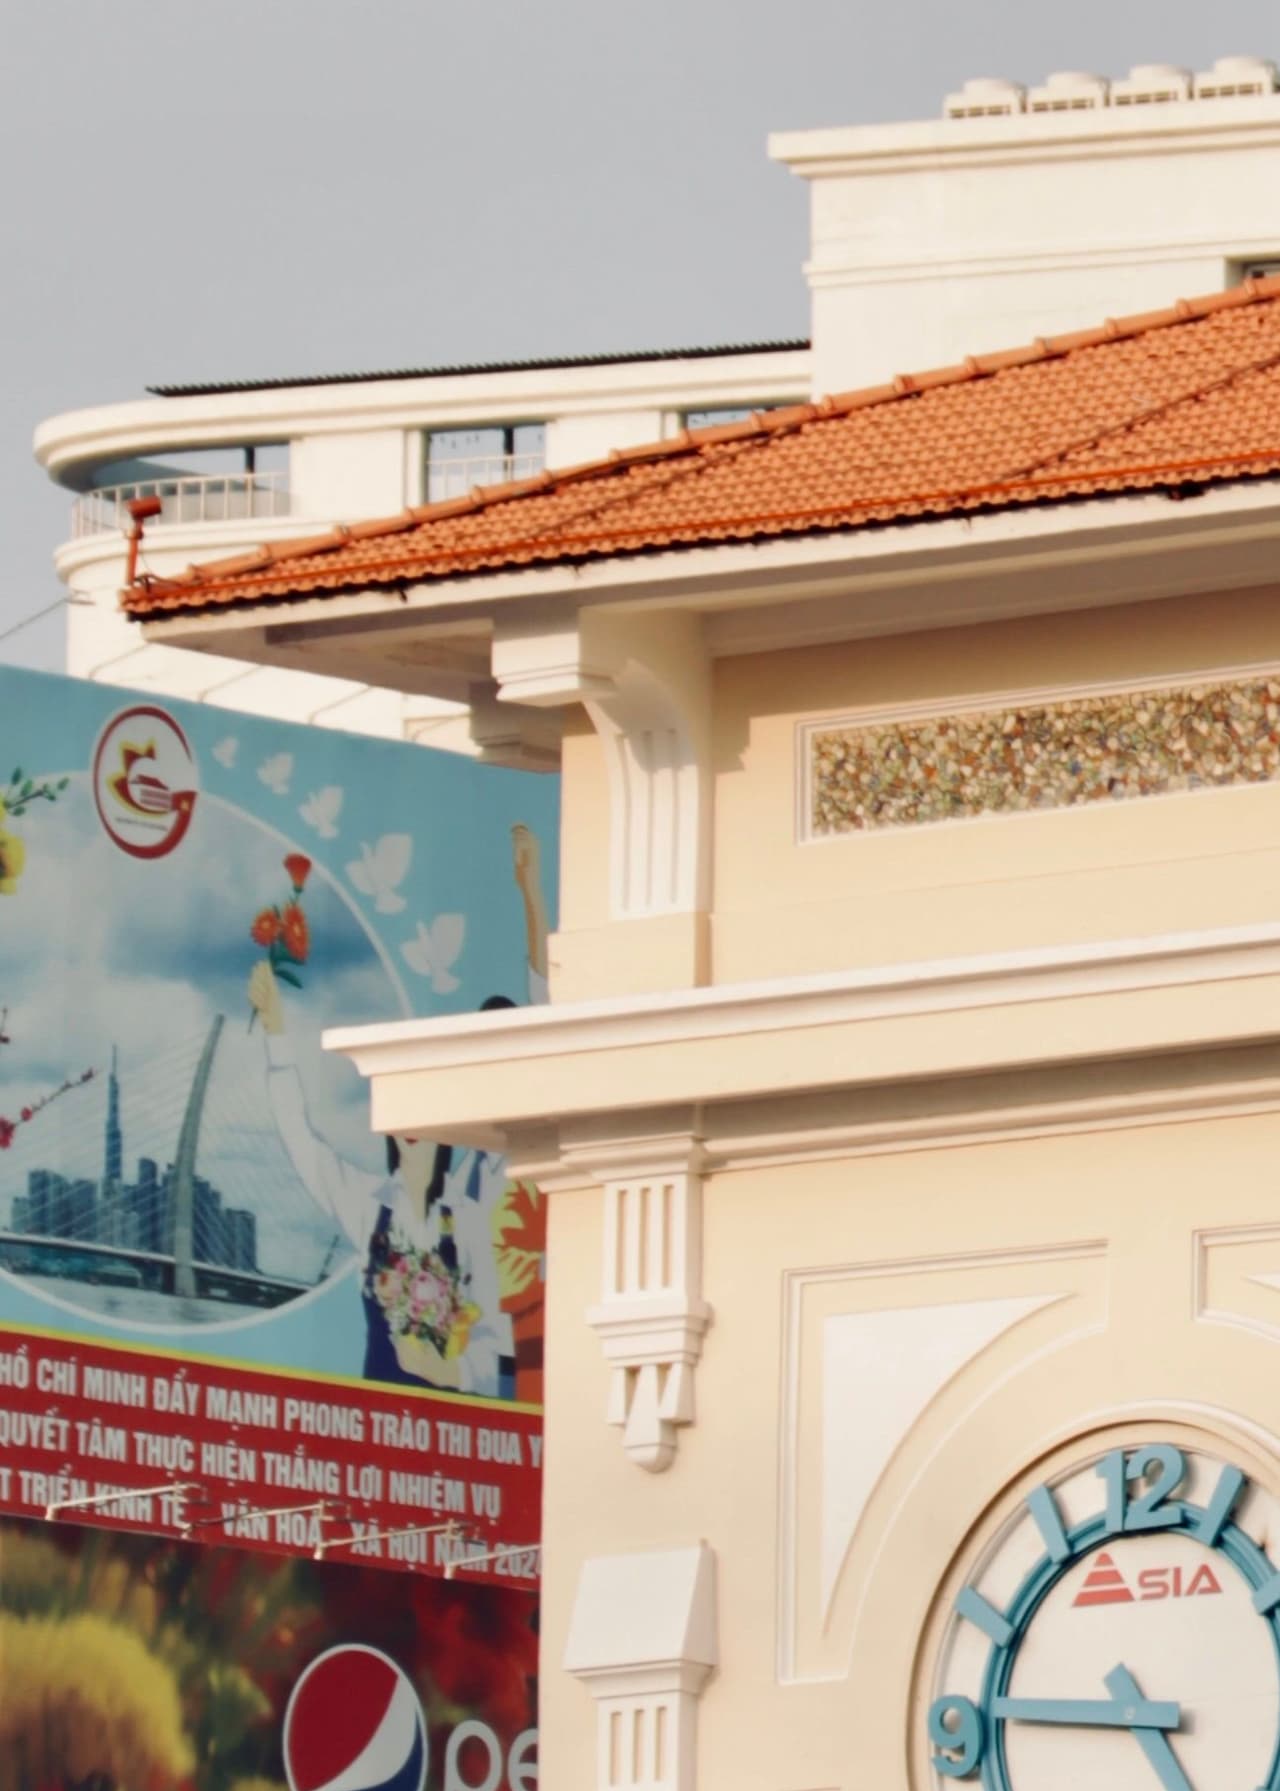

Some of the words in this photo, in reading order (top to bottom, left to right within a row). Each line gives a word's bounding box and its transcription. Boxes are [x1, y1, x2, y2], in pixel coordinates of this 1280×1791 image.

[37, 1357, 77, 1396] CHÍ
[83, 1365, 146, 1408] MINH
[153, 1367, 200, 1416] ĐẨY
[206, 1386, 278, 1431] MẠNH
[284, 1398, 364, 1442] PHONG
[370, 1409, 431, 1452] TRÀO
[436, 1421, 471, 1458] THI
[477, 1427, 523, 1466] ĐUA
[75, 1417, 127, 1462] TÂM
[133, 1430, 195, 1478] THỰC
[201, 1439, 257, 1487] HIỆN
[346, 1463, 383, 1507] LỢI
[389, 1470, 466, 1518] NHIỆM
[471, 1482, 502, 1526] VỤ
[1096, 1443, 1188, 1534] 12
[94, 1481, 153, 1523] KINH
[221, 1498, 269, 1542] VĂN
[351, 1517, 382, 1557] XÃ
[388, 1523, 428, 1570] HỘI
[1071, 1552, 1223, 1607] ASIA
[928, 1694, 985, 1781] 9
